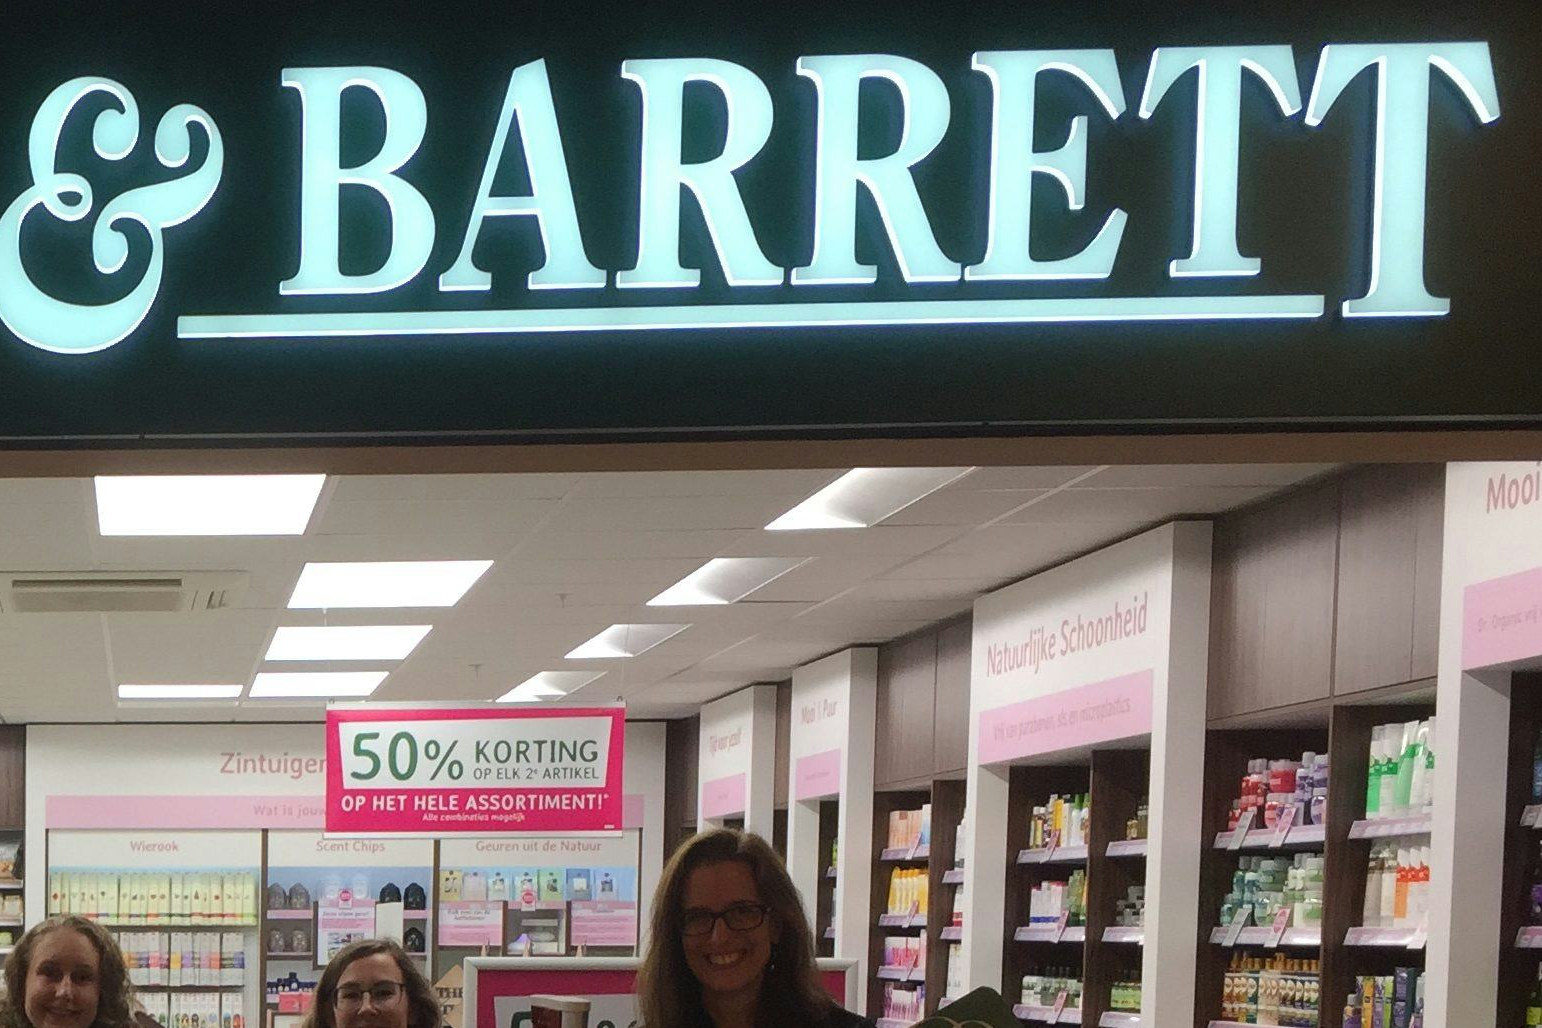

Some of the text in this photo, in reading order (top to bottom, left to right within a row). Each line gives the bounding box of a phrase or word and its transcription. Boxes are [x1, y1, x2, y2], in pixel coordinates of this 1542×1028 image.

[280, 41, 1502, 320] BARRETT
[1486, 461, 1541, 514] Mooi
[987, 592, 1148, 678] Natuurlijke Schoonheid
[350, 731, 464, 781] 50%
[475, 739, 598, 763] KORTING
[473, 767, 492, 780] OP
[496, 767, 521, 780] ELK
[542, 767, 600, 780] ARTIKEL
[253, 805, 277, 816] Wat
[283, 805, 293, 816] is
[340, 795, 366, 812] OP
[372, 795, 408, 811] HET
[414, 795, 458, 811] HELE
[422, 812, 526, 824] Alle combinaties mogelijk
[130, 840, 179, 852] Wierook
[316, 840, 385, 854] Scent Chips
[476, 840, 602, 852] Geuren uit de Natuur
